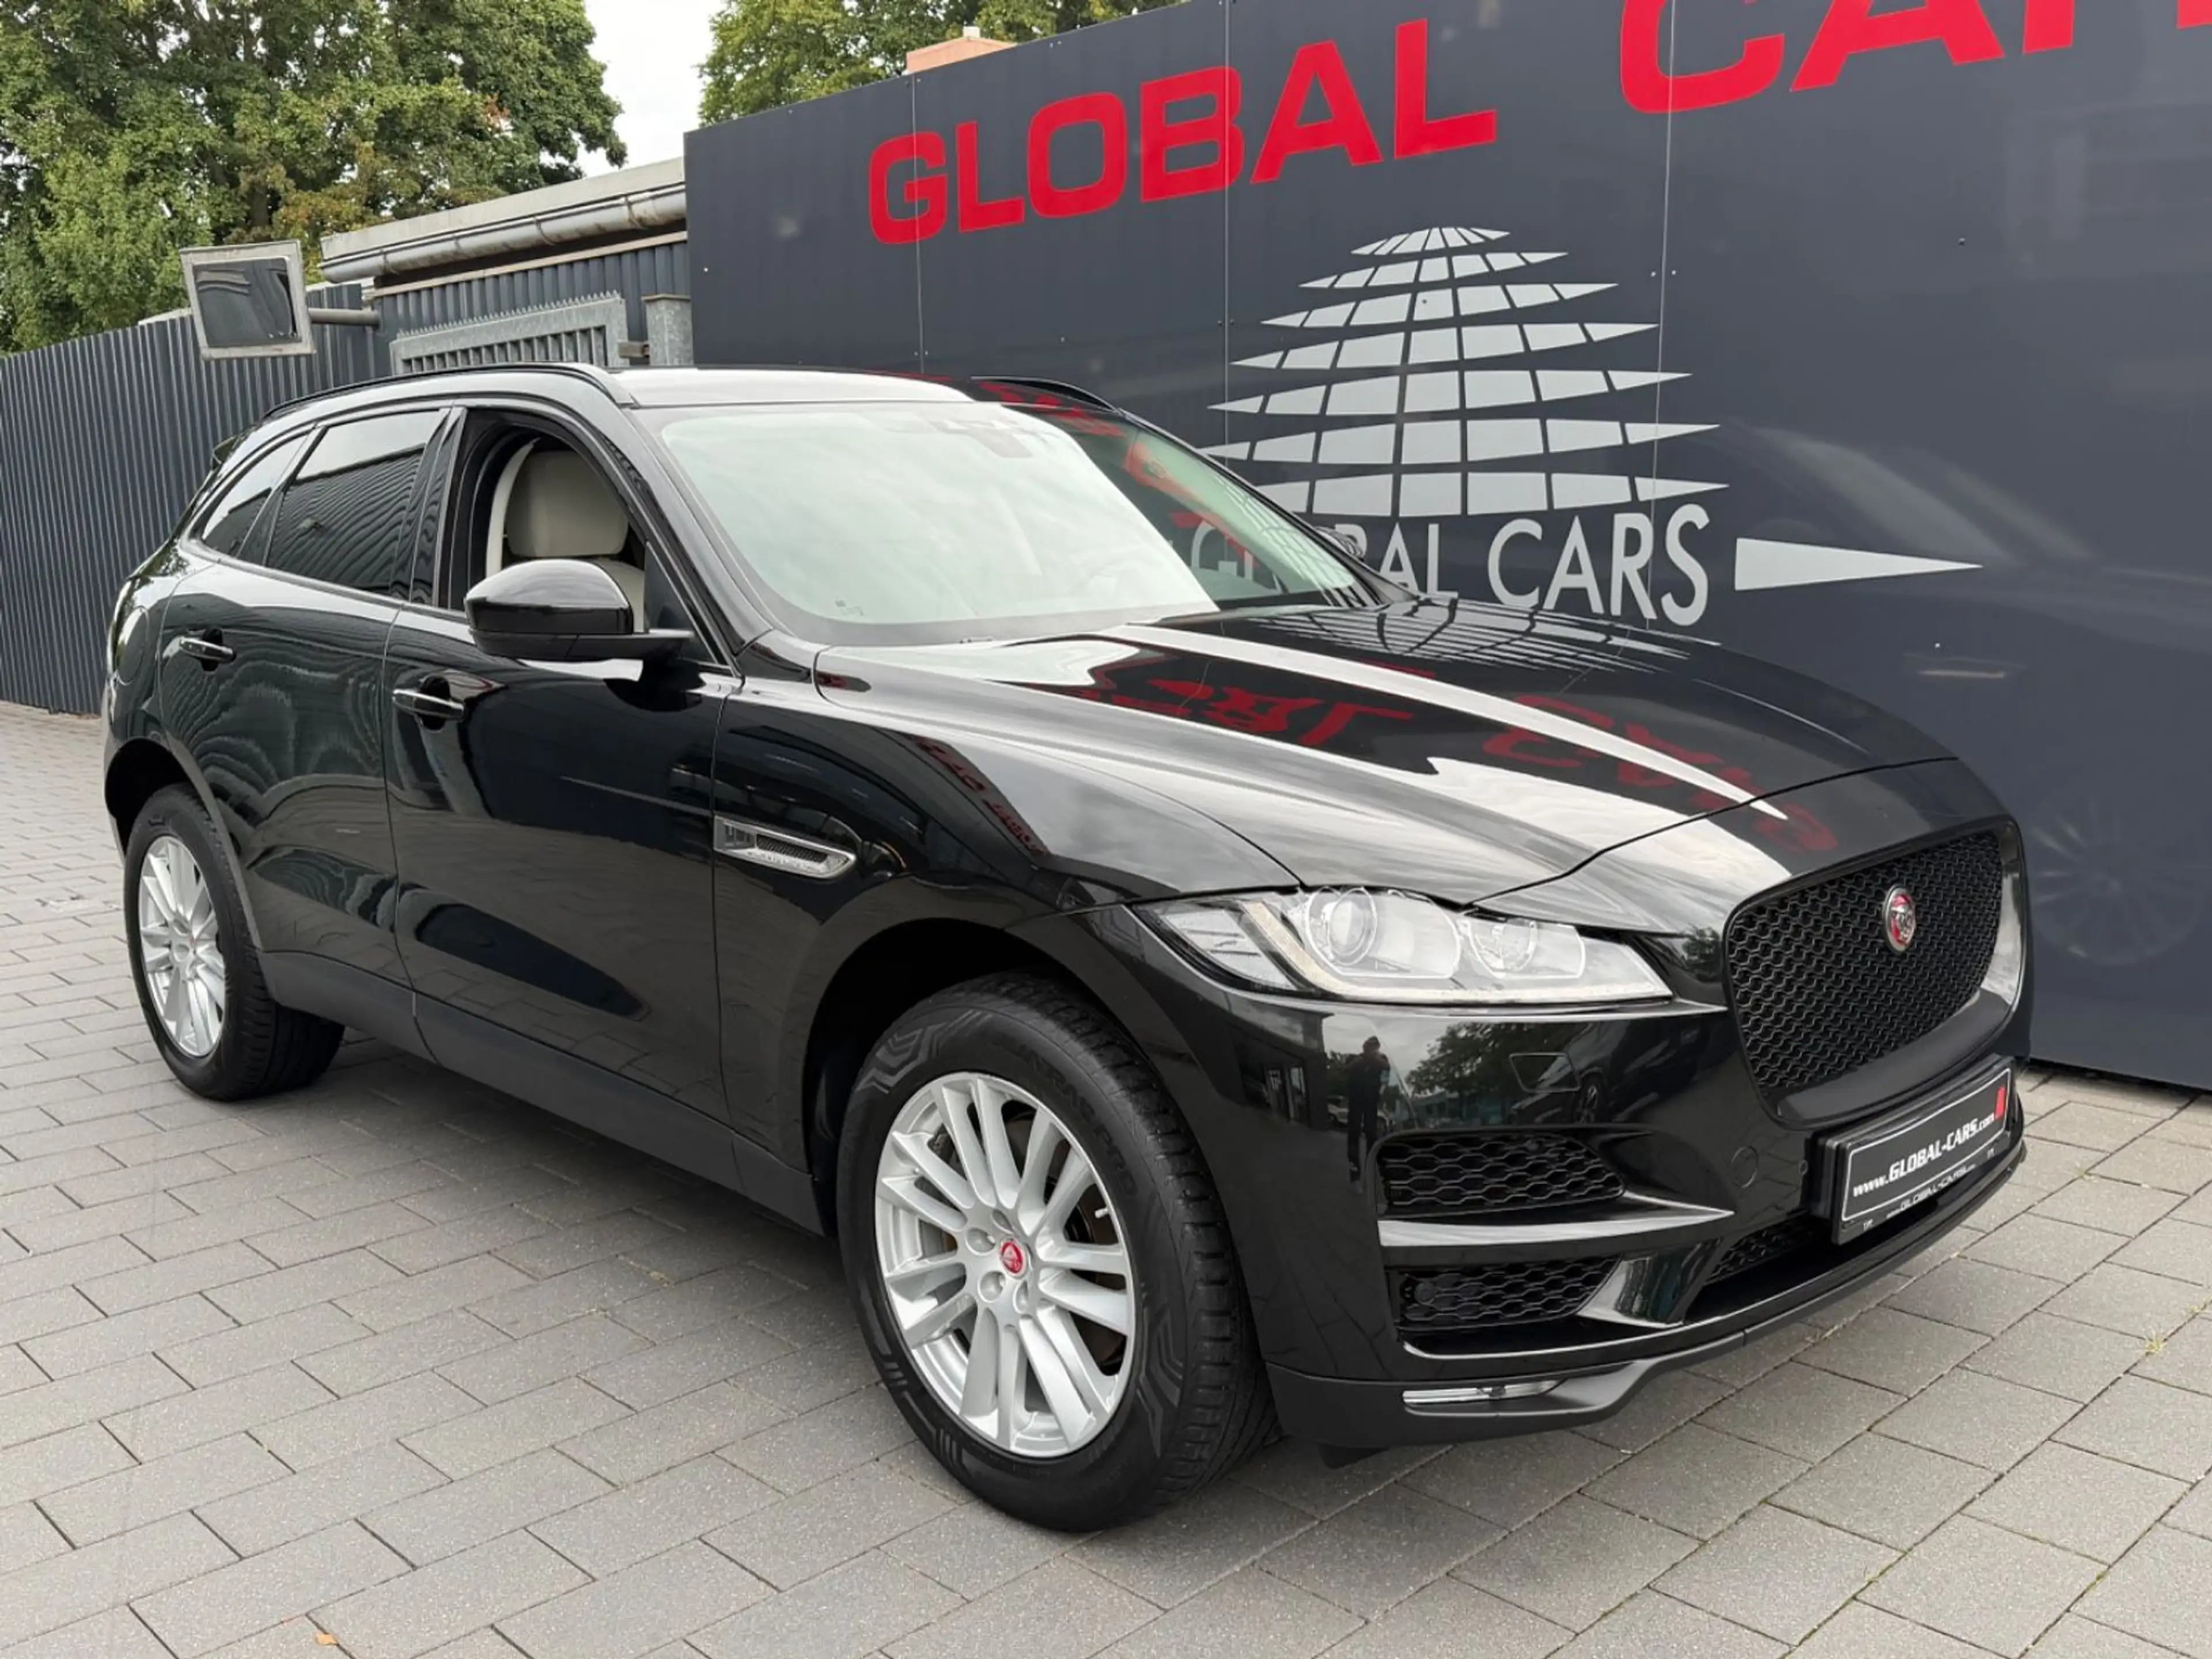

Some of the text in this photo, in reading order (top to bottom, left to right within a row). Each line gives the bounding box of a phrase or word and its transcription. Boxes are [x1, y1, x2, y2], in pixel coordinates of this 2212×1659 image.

[868, 18, 1497, 244] GLOBAL
[1488, 503, 1710, 626] CARS
[1853, 1112, 1994, 1197] www.GLOBAL-CARS.com
